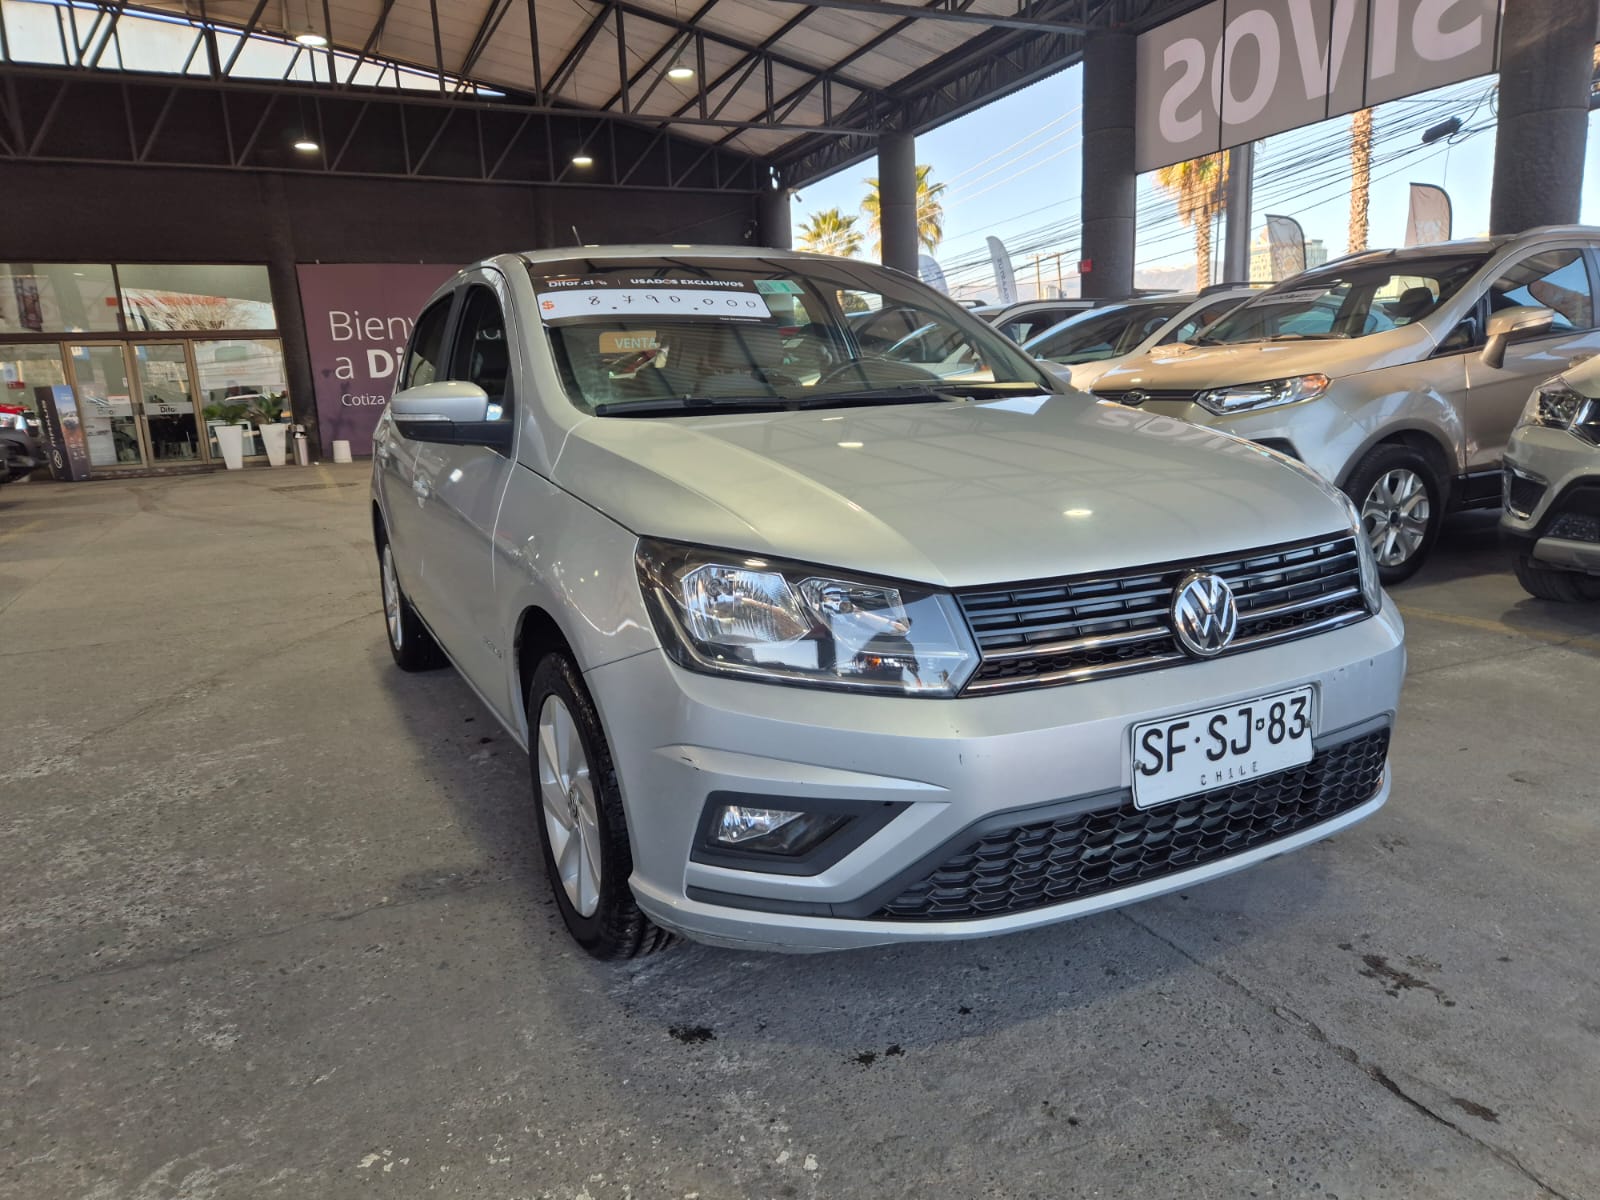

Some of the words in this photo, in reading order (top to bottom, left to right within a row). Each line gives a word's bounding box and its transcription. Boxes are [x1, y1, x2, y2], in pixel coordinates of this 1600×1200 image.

[680, 279, 744, 288] EXCLUSIVOS
[335, 356, 354, 380] a
[341, 393, 386, 407] Cotiza
[1200, 760, 1259, 786] CHILE
